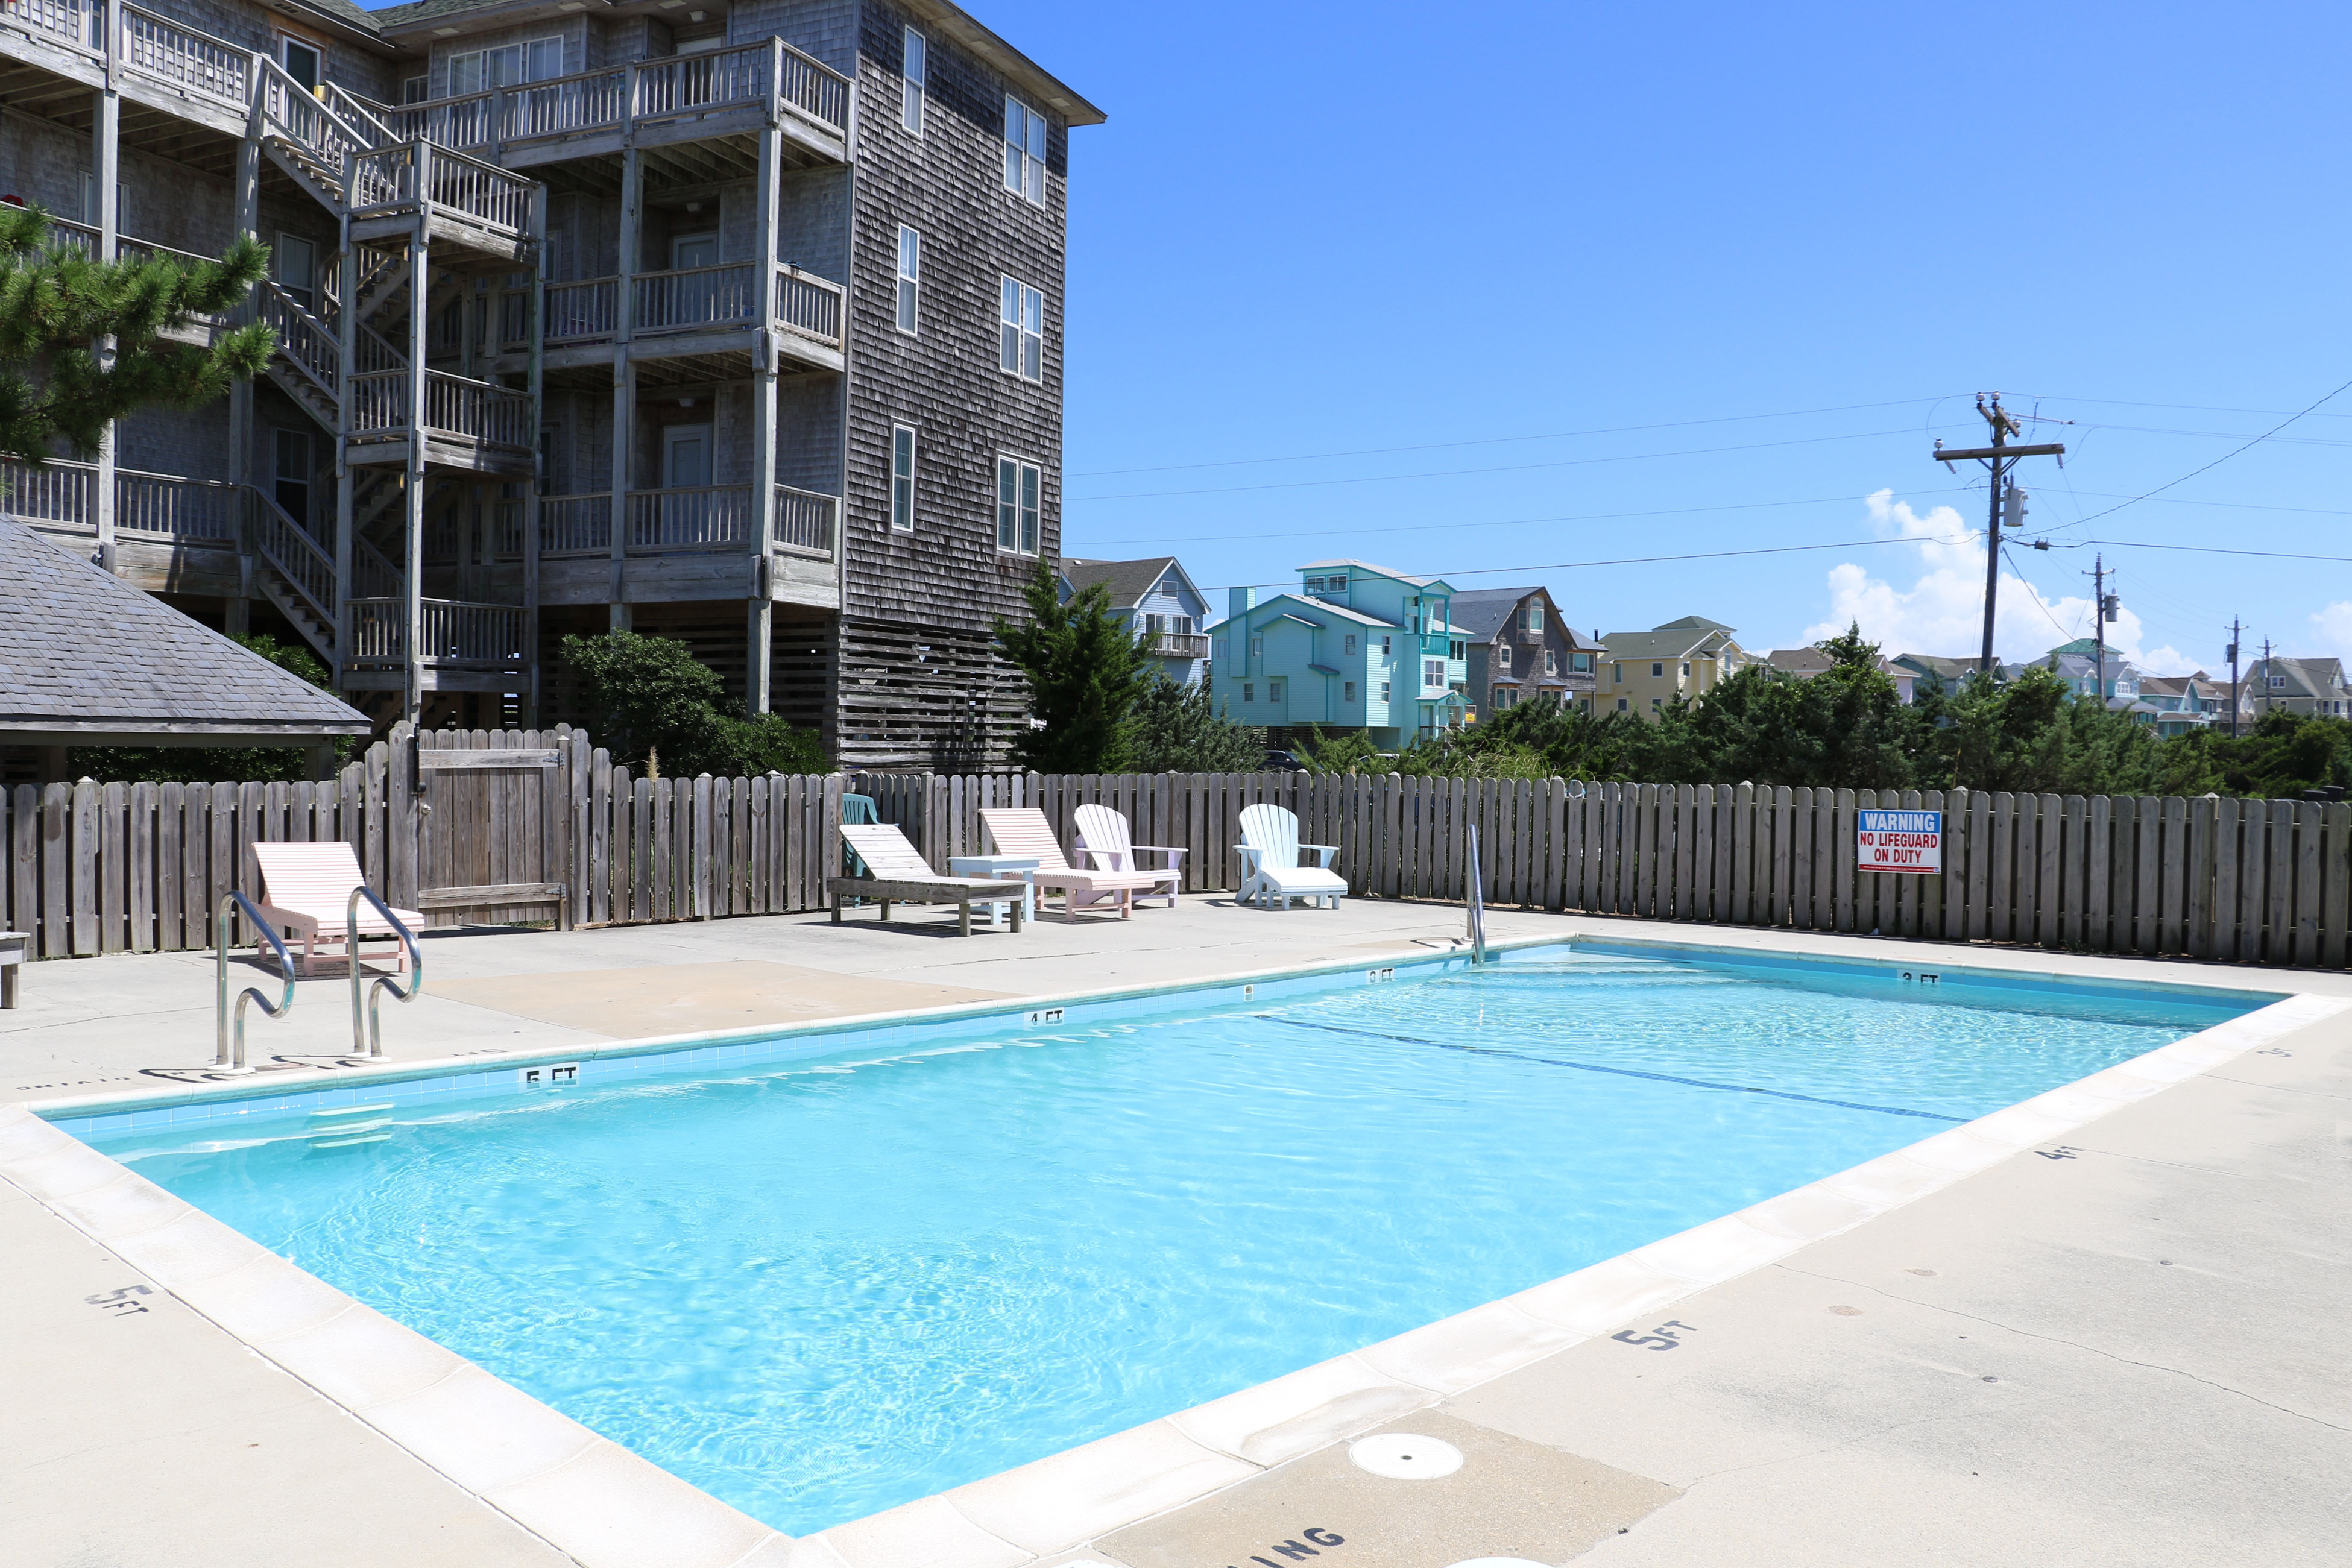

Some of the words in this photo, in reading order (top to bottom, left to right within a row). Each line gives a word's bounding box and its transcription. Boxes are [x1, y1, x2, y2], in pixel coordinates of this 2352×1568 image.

[1865, 813, 1935, 832] WARNING
[1860, 832, 1874, 846] NO
[1879, 833, 1938, 848] LIFEGUARD
[1874, 848, 1888, 862] ON
[1893, 849, 1922, 863] DUTY
[1920, 974, 1938, 983] FT
